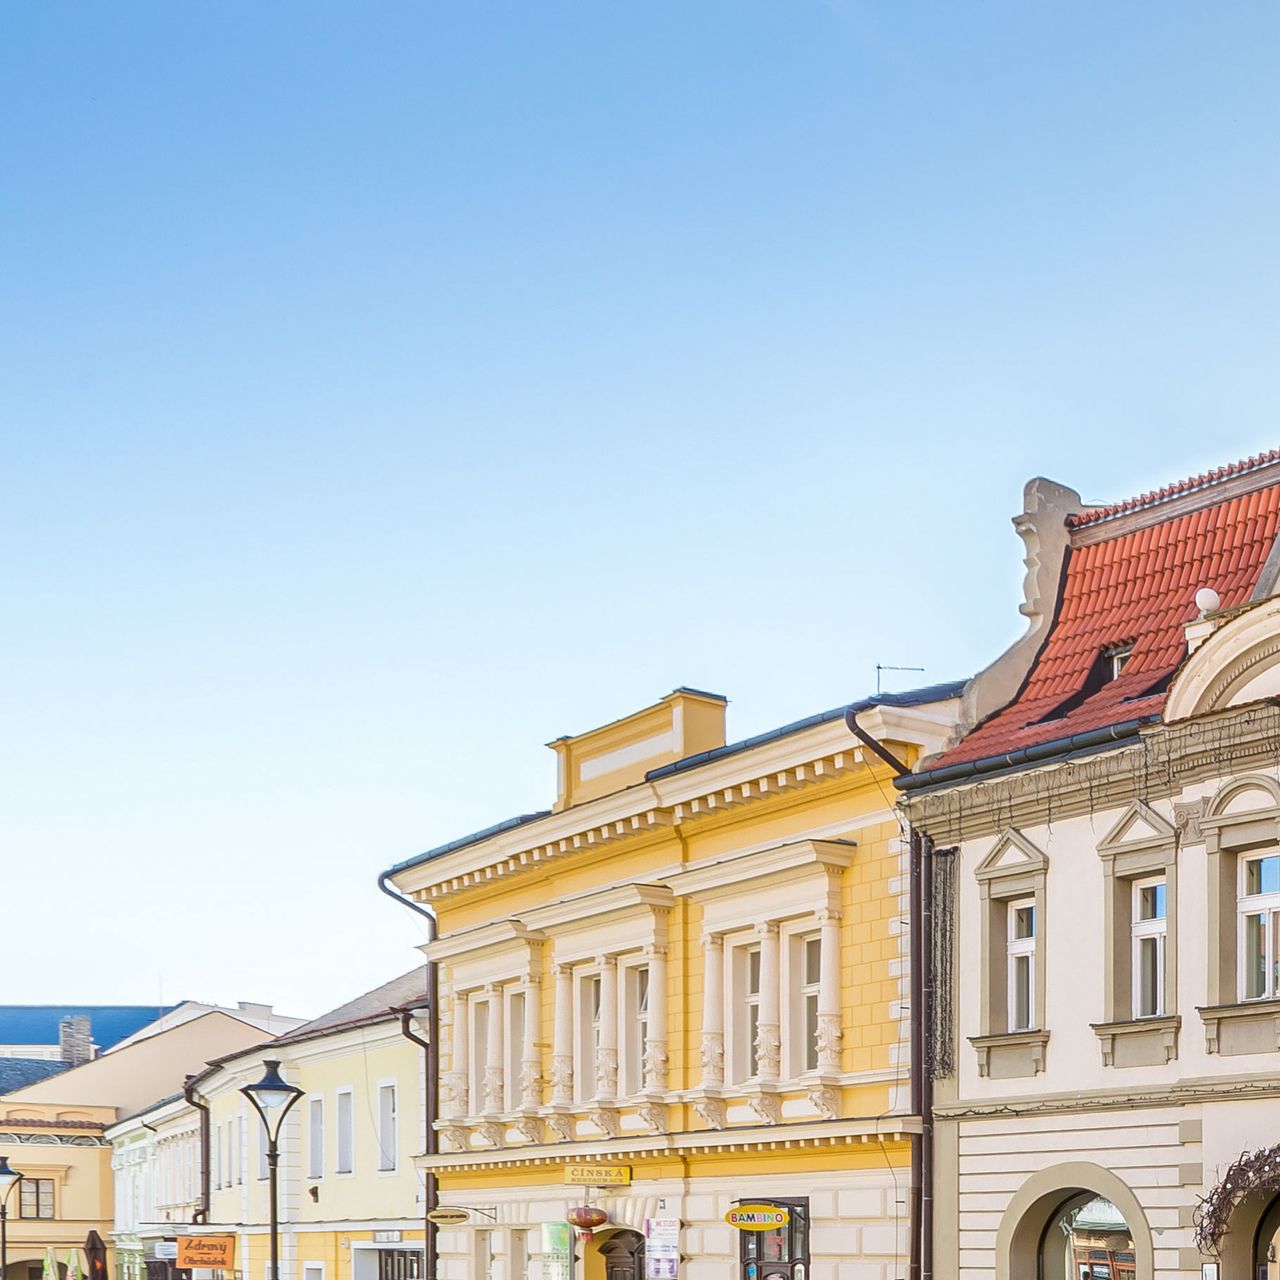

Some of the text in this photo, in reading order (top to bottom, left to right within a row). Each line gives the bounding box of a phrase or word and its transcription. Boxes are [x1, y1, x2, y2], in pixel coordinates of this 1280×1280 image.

[571, 1167, 624, 1177] ČÍNSKÁ
[731, 1213, 783, 1223] BAMBINO
[184, 1239, 227, 1254] Zdravý
